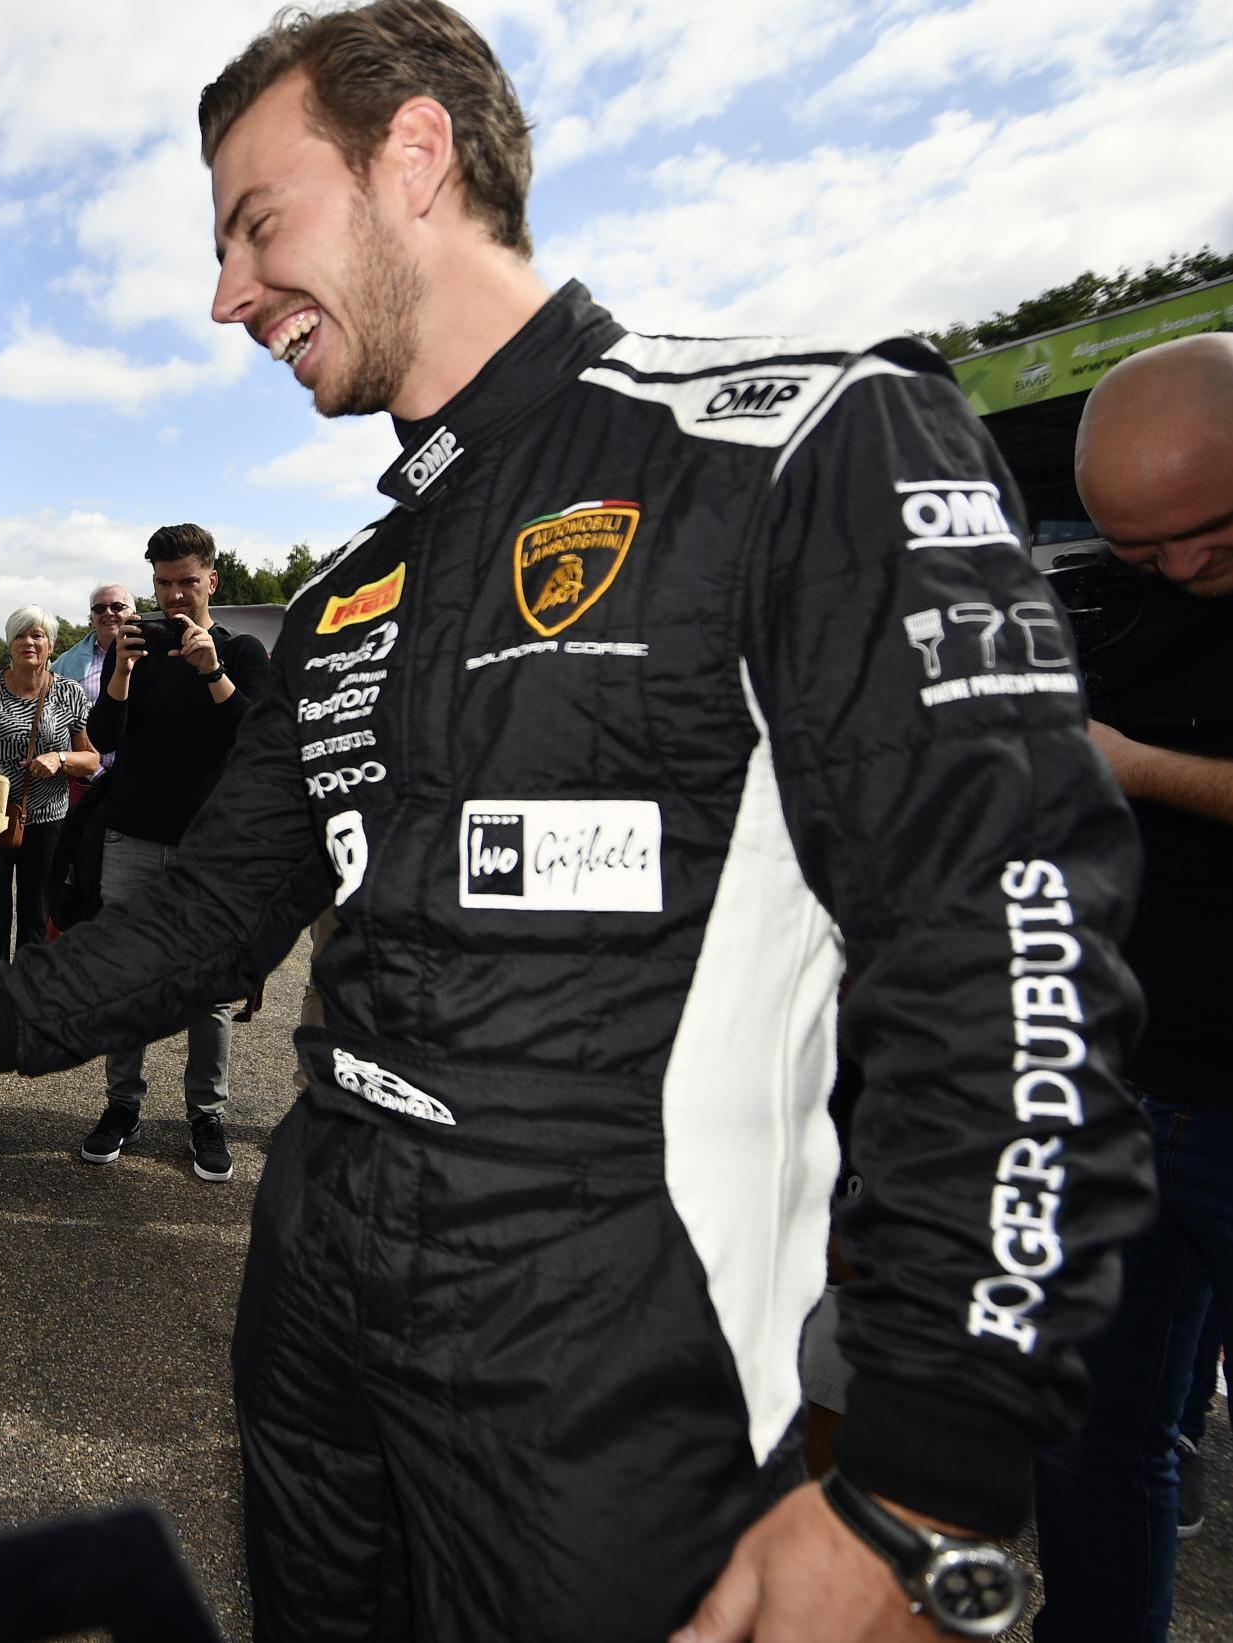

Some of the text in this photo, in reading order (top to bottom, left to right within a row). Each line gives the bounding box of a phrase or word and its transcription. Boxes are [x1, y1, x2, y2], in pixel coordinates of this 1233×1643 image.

[706, 384, 799, 414] OMP
[407, 431, 457, 488] OMP
[530, 515, 622, 546] AUTOMOBILI
[902, 491, 1010, 536] OM
[523, 533, 624, 568] LAMBORGHINI
[968, 859, 1087, 1355] ROGER DUBUIS
